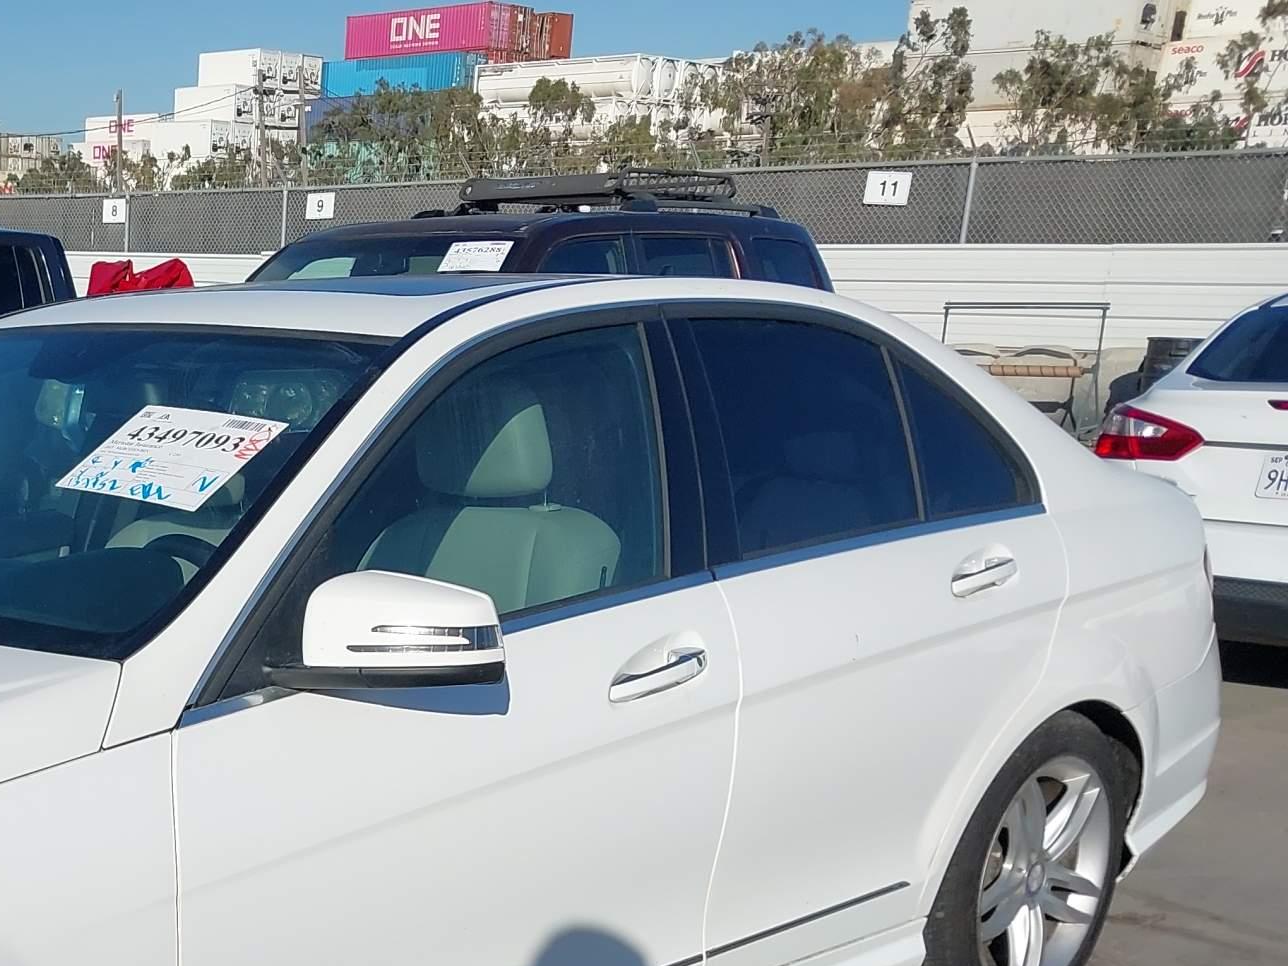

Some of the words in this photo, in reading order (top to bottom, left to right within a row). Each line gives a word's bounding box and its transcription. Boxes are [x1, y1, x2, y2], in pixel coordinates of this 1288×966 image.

[390, 13, 441, 42] ONE
[1171, 43, 1205, 55] seaco
[878, 180, 899, 198] 11
[111, 205, 118, 217] 8
[316, 199, 324, 213] 9
[127, 425, 246, 453] 43497093
[1271, 456, 1283, 464] SEP
